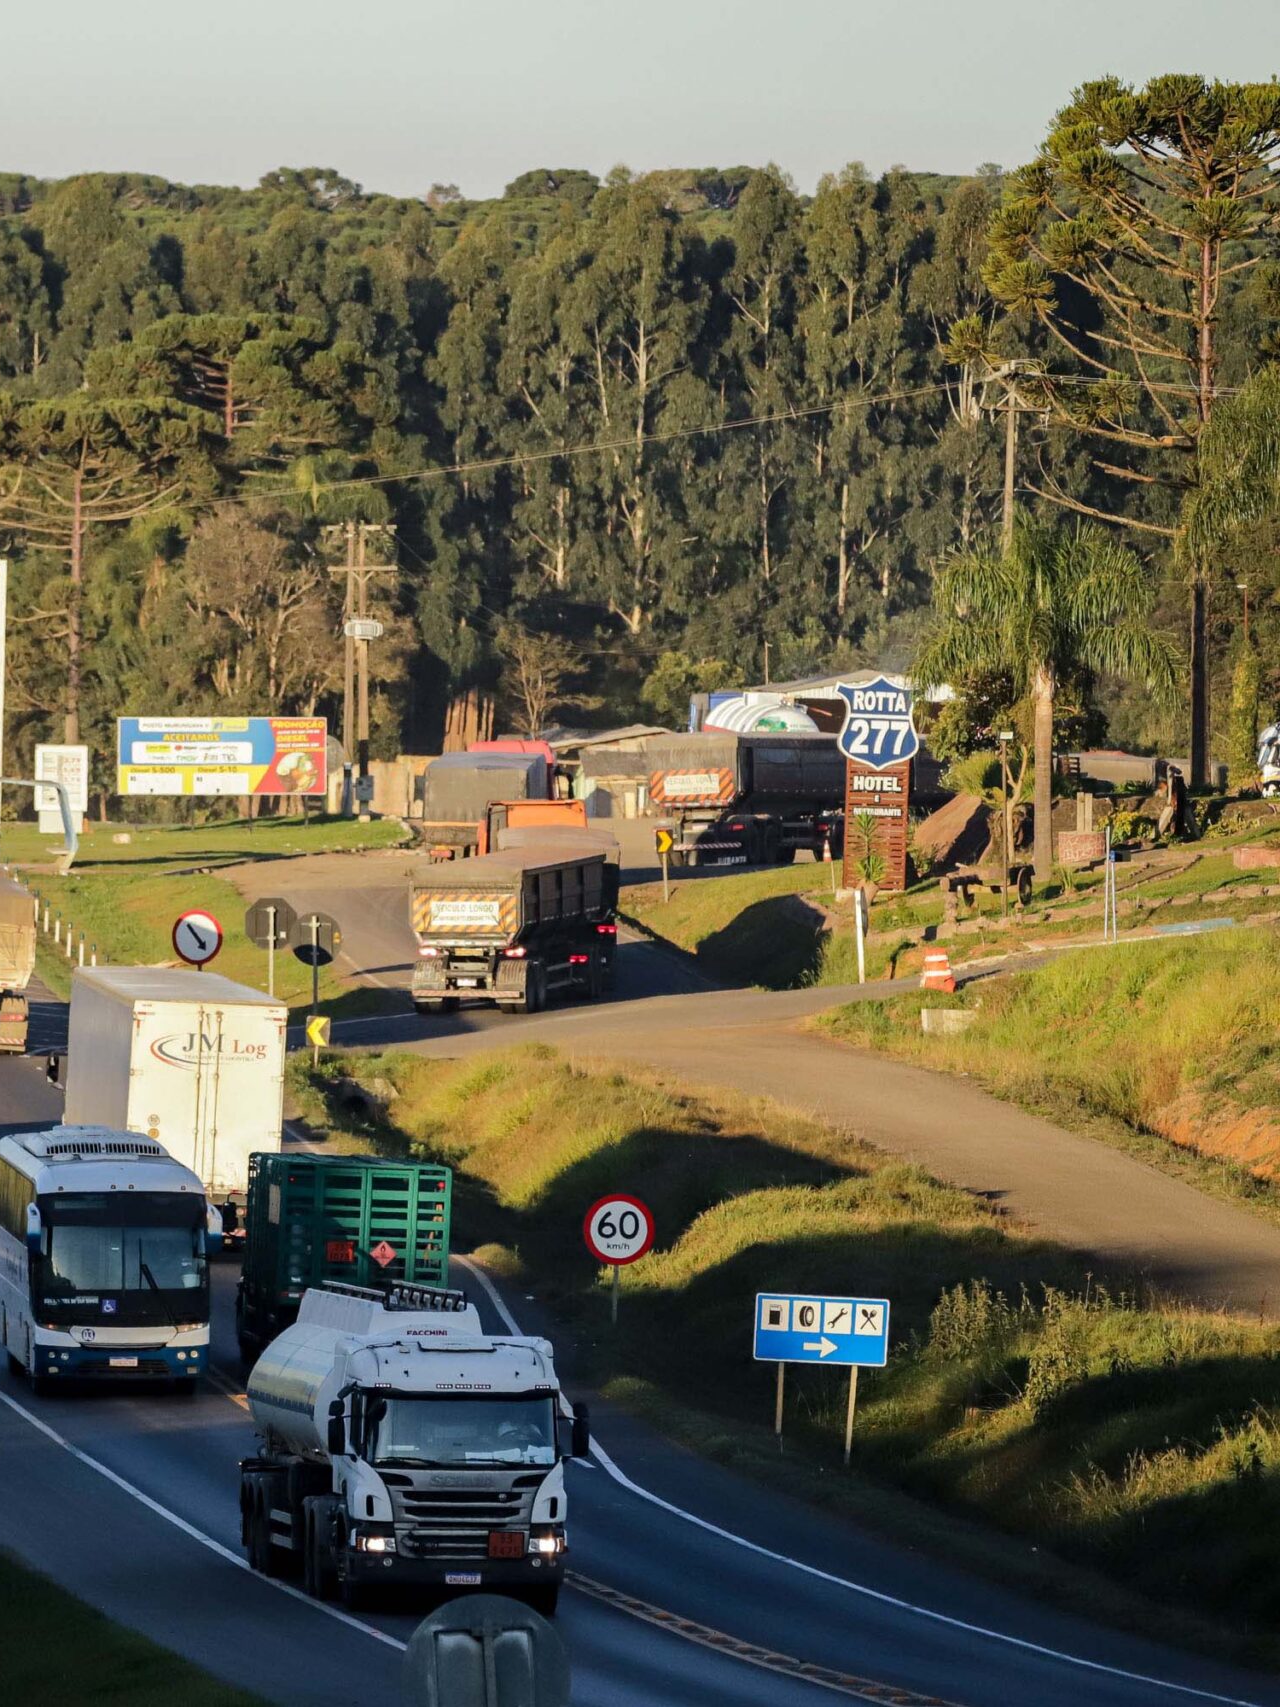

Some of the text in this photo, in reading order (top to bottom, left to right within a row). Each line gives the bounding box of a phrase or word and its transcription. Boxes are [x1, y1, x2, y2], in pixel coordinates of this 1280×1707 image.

[853, 690, 907, 712] ROTTA
[163, 733, 220, 742] ACEITAMOS
[276, 734, 308, 742] DIESEL
[849, 719, 910, 755] 277
[853, 775, 902, 792] HOTEL
[182, 1032, 268, 1060] JM Log
[597, 1210, 640, 1240] 60
[606, 1242, 630, 1250] km/h
[406, 1329, 448, 1337] FACCHINI
